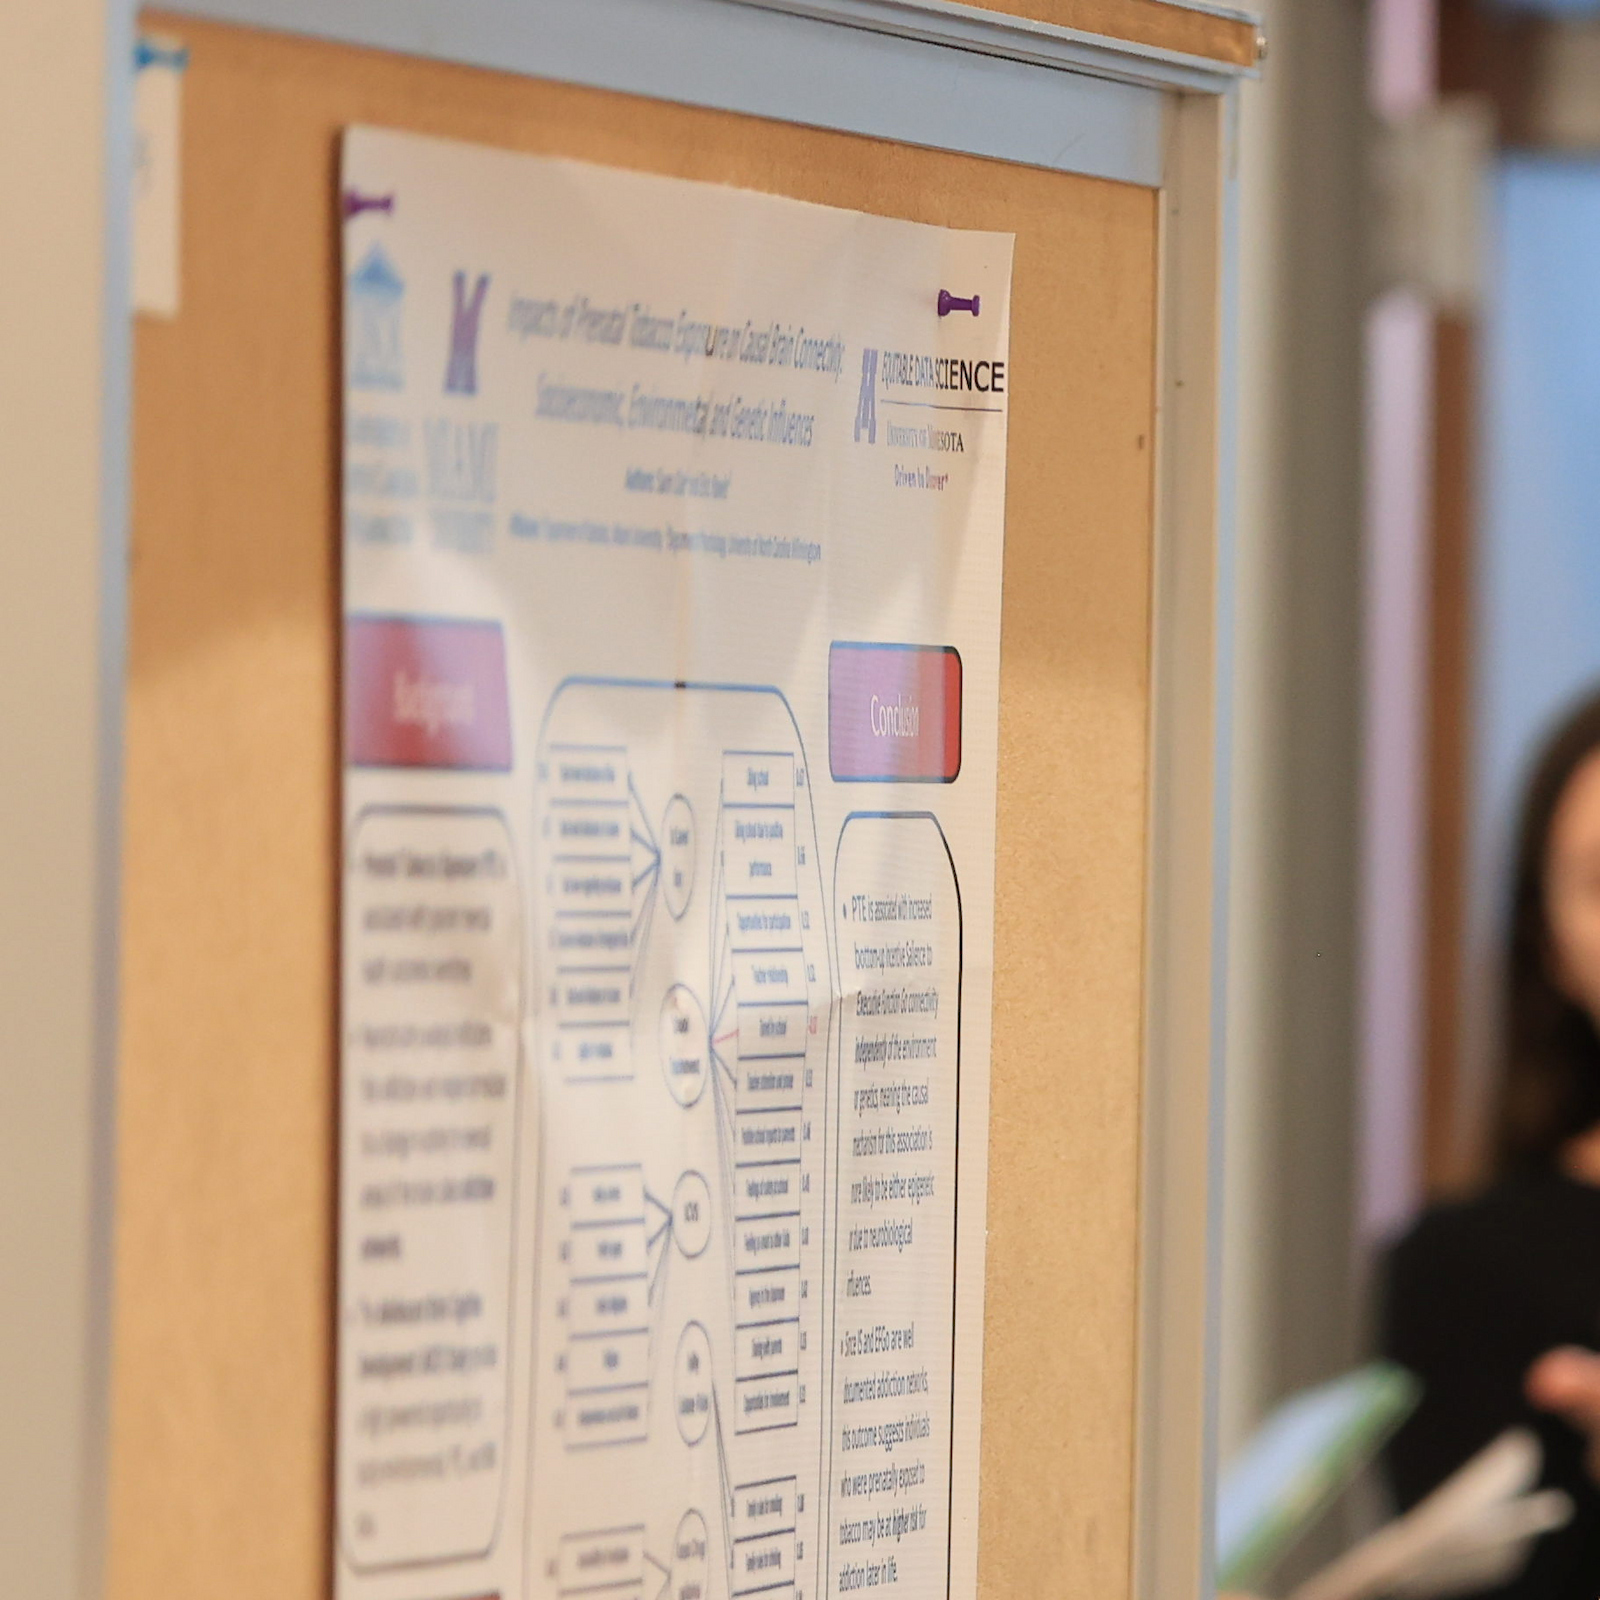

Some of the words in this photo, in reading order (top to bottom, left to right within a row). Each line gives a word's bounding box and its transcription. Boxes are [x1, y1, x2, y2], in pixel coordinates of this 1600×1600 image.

[915, 355, 934, 387] DATA
[934, 357, 1004, 393] SCIENCE
[871, 695, 919, 737] Conclusion
[852, 895, 866, 921] PTE
[897, 1125, 927, 1153] association
[890, 1329, 903, 1351] are
[877, 1370, 905, 1399] addiction
[878, 1419, 904, 1452] suggests
[862, 1519, 876, 1548] may
